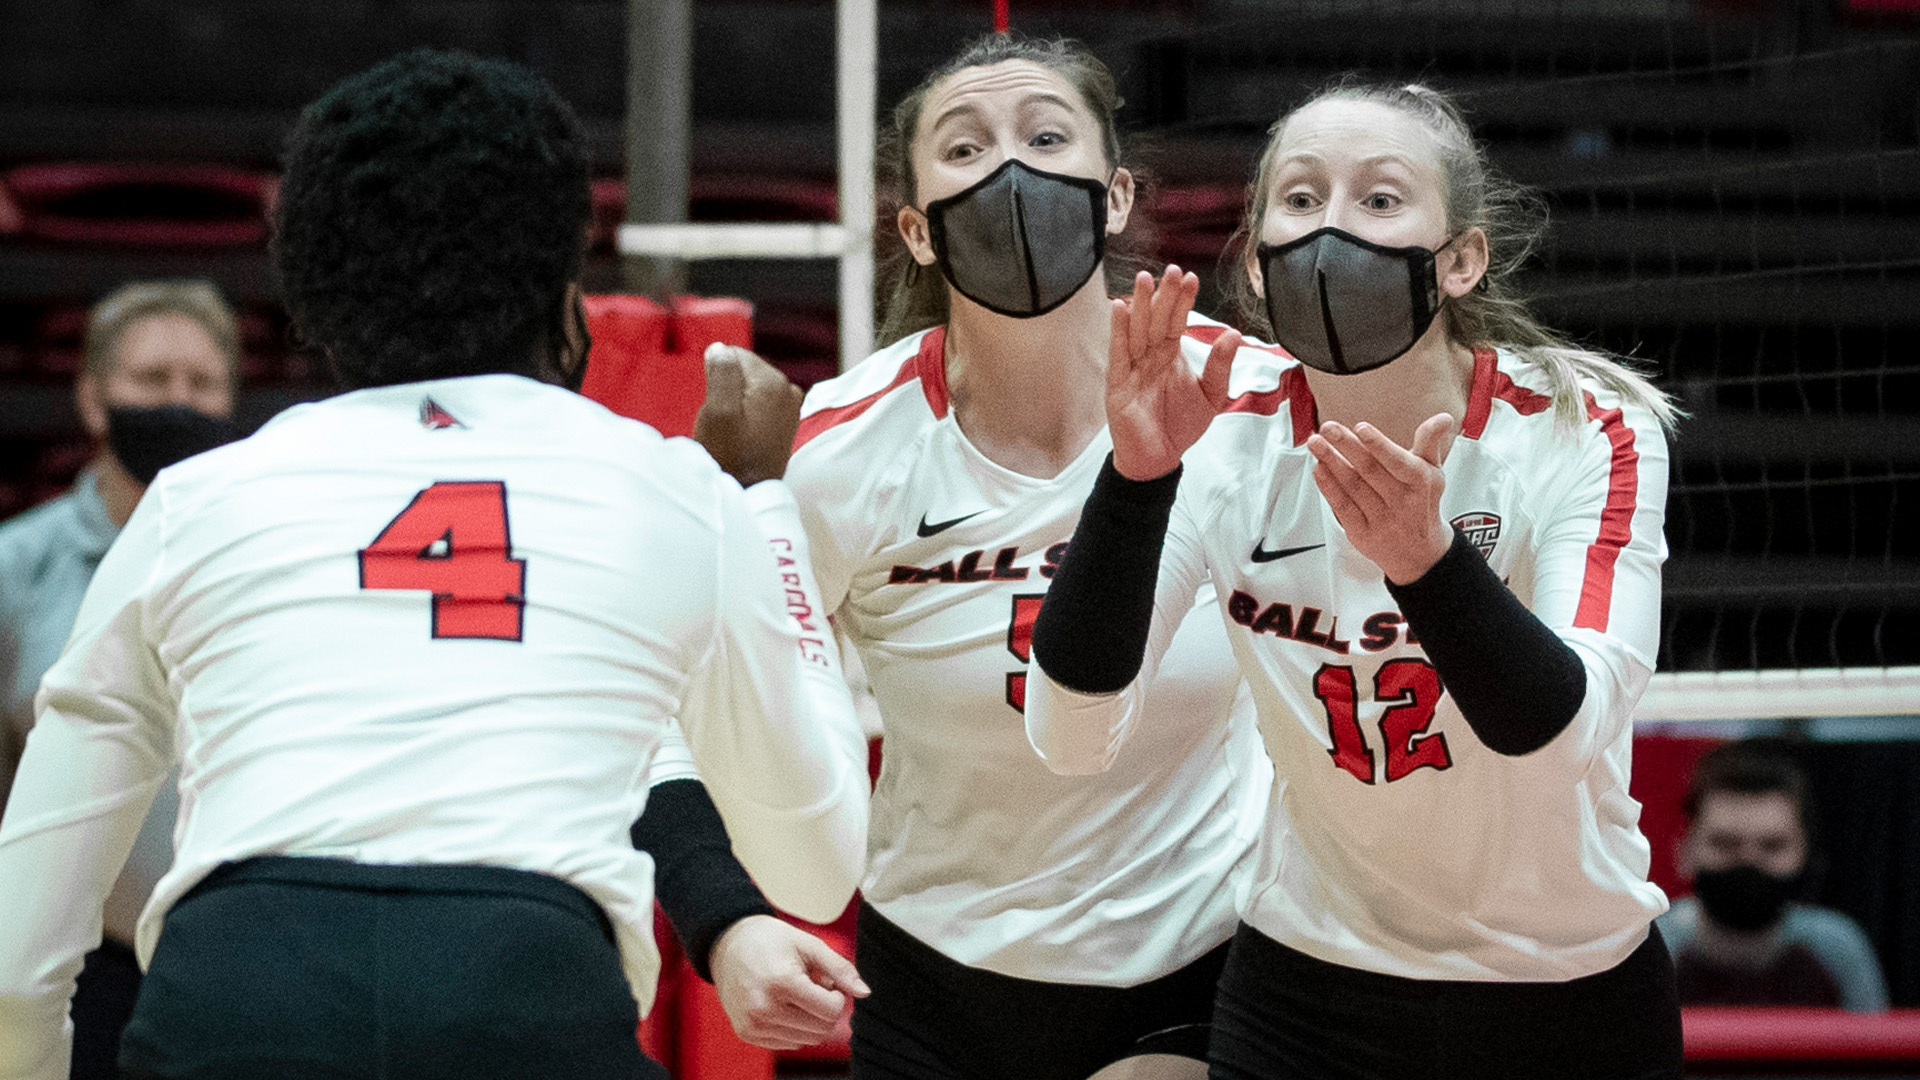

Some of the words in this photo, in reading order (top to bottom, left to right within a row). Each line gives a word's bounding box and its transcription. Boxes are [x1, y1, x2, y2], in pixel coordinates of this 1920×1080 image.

[358, 481, 527, 642] 4
[1465, 527, 1498, 546] AC
[1228, 589, 1351, 654] BALL
[1313, 657, 1453, 785] 12
